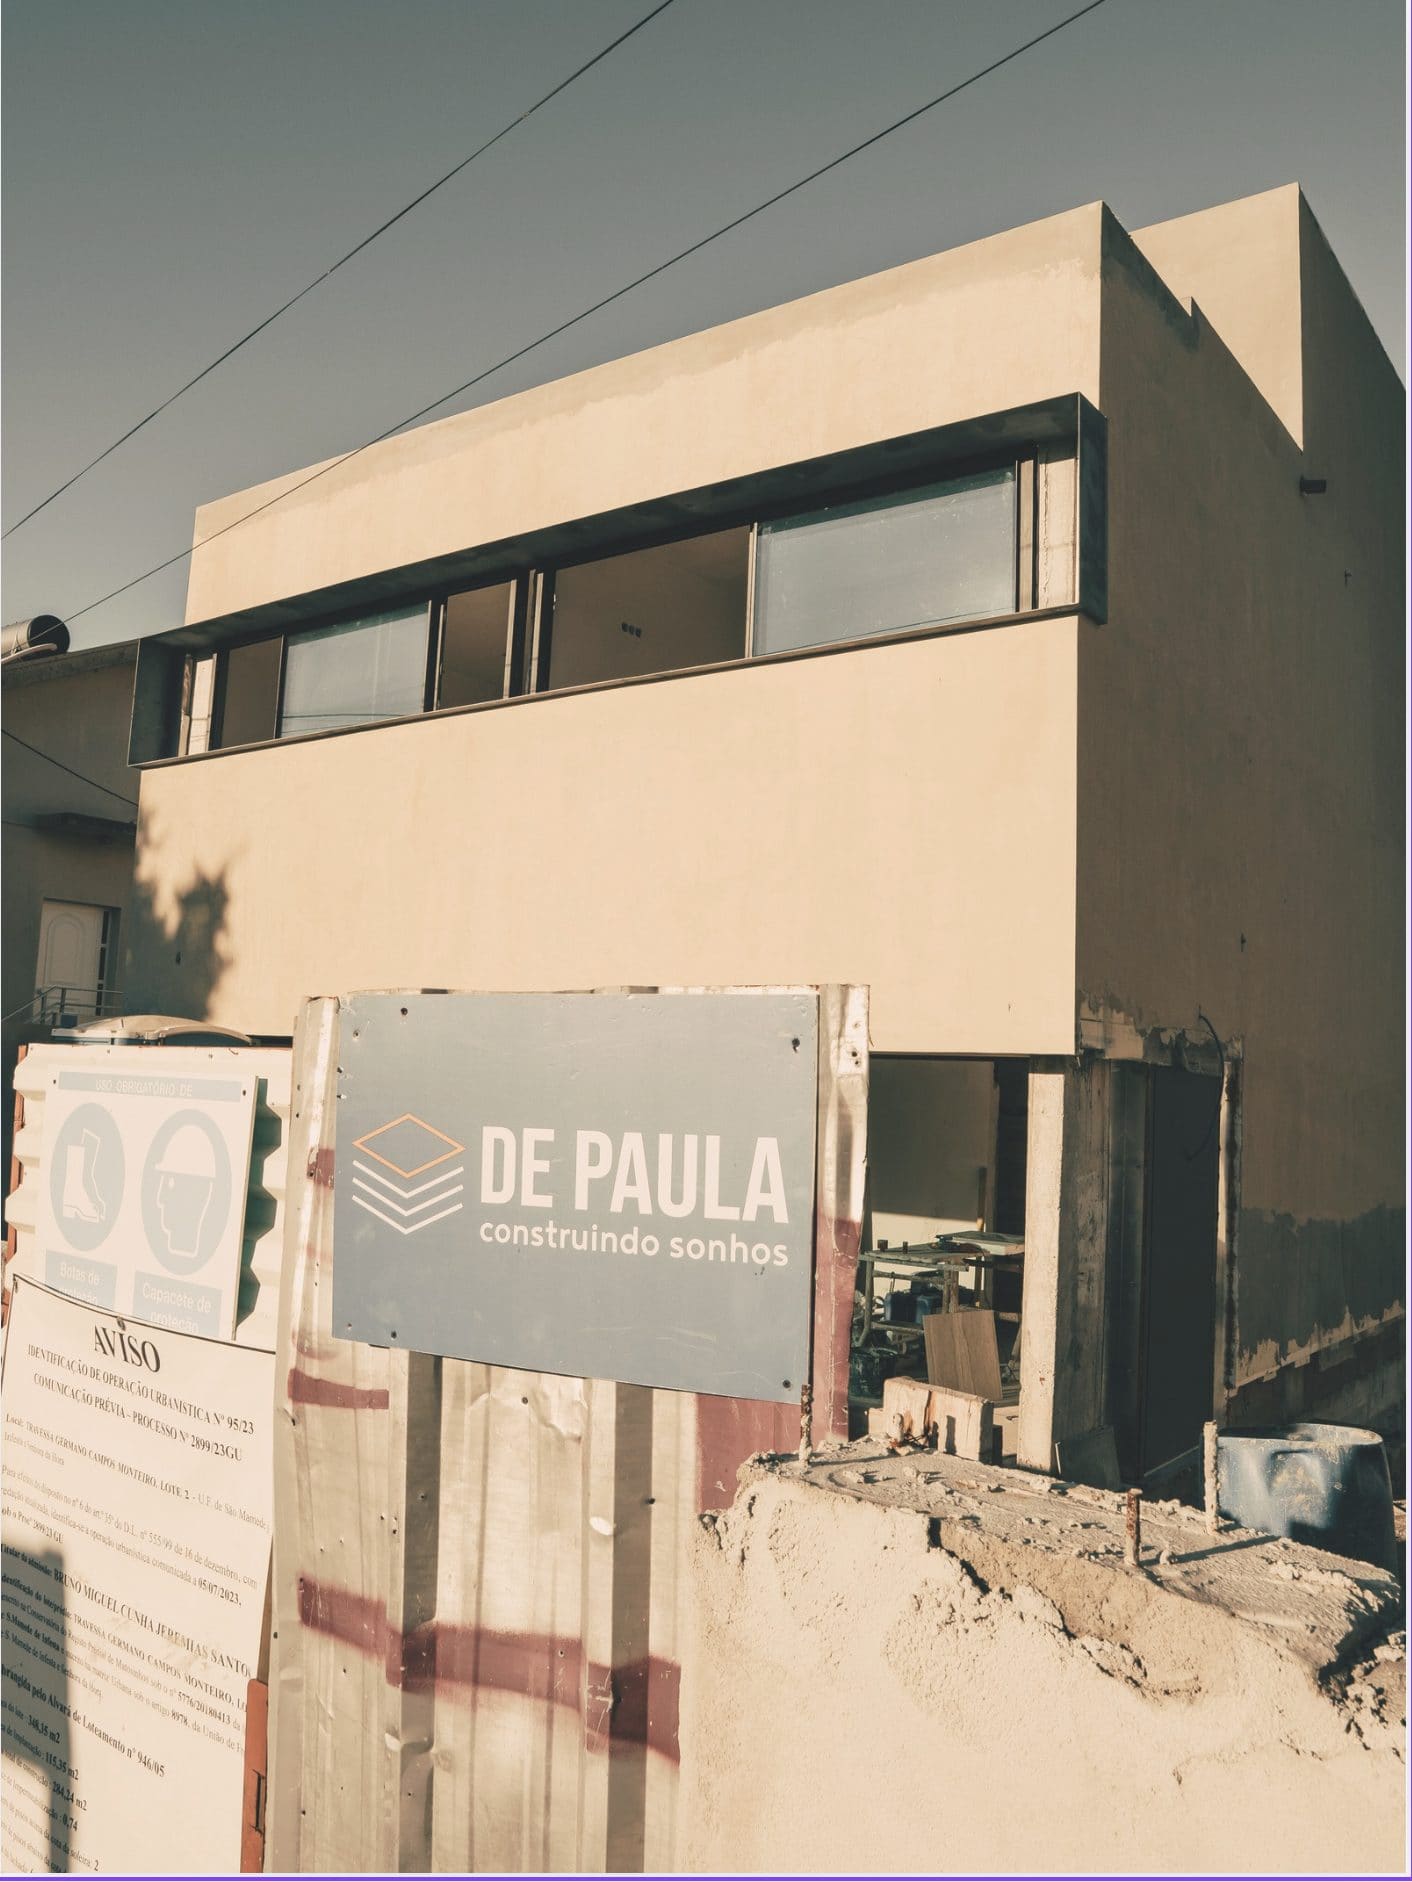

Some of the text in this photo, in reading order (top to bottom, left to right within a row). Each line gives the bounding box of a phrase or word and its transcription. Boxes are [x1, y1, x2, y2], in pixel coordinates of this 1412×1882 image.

[95, 1079, 112, 1092] USO
[178, 1083, 193, 1097] DE
[480, 1126, 789, 1223] DE PAULA
[480, 1219, 789, 1266] construindo sonhos
[143, 1282, 212, 1313] Capacete de
[94, 1325, 160, 1373] AVISO
[28, 1343, 88, 1376] IDENTIFICAÇÃO
[90, 1366, 101, 1381] DE
[102, 1371, 149, 1399] OPERAÇÃO
[227, 1416, 255, 1435] 95/23
[33, 1372, 93, 1406] COMUNICAÇÃO
[94, 1396, 126, 1419] PRÉVIA
[132, 1410, 178, 1440] PROCESSO
[191, 1434, 242, 1461] 2899/23GU
[26, 1421, 54, 1443] TRAVESSA
[55, 1434, 87, 1457] GERMANO
[88, 1449, 116, 1469] CAMPOS
[160, 1480, 181, 1497] LOTE
[184, 1489, 190, 1500] 2
[54, 1568, 82, 1594] BRUNO
[84, 1584, 120, 1614] MIGUEL
[120, 1604, 154, 1632] CUNHA
[73, 1613, 106, 1640] TRAVESSA
[107, 1632, 145, 1660] GERMANO
[147, 1654, 182, 1680] CAMPOS
[1, 1664, 31, 1692] brangida
[72, 1709, 82, 1724] de
[83, 1715, 126, 1755] Loteamento
[137, 1750, 166, 1778] 946/05
[67, 1768, 79, 1780] m2
[75, 1798, 87, 1812] m2
[93, 1859, 99, 1872] 2
